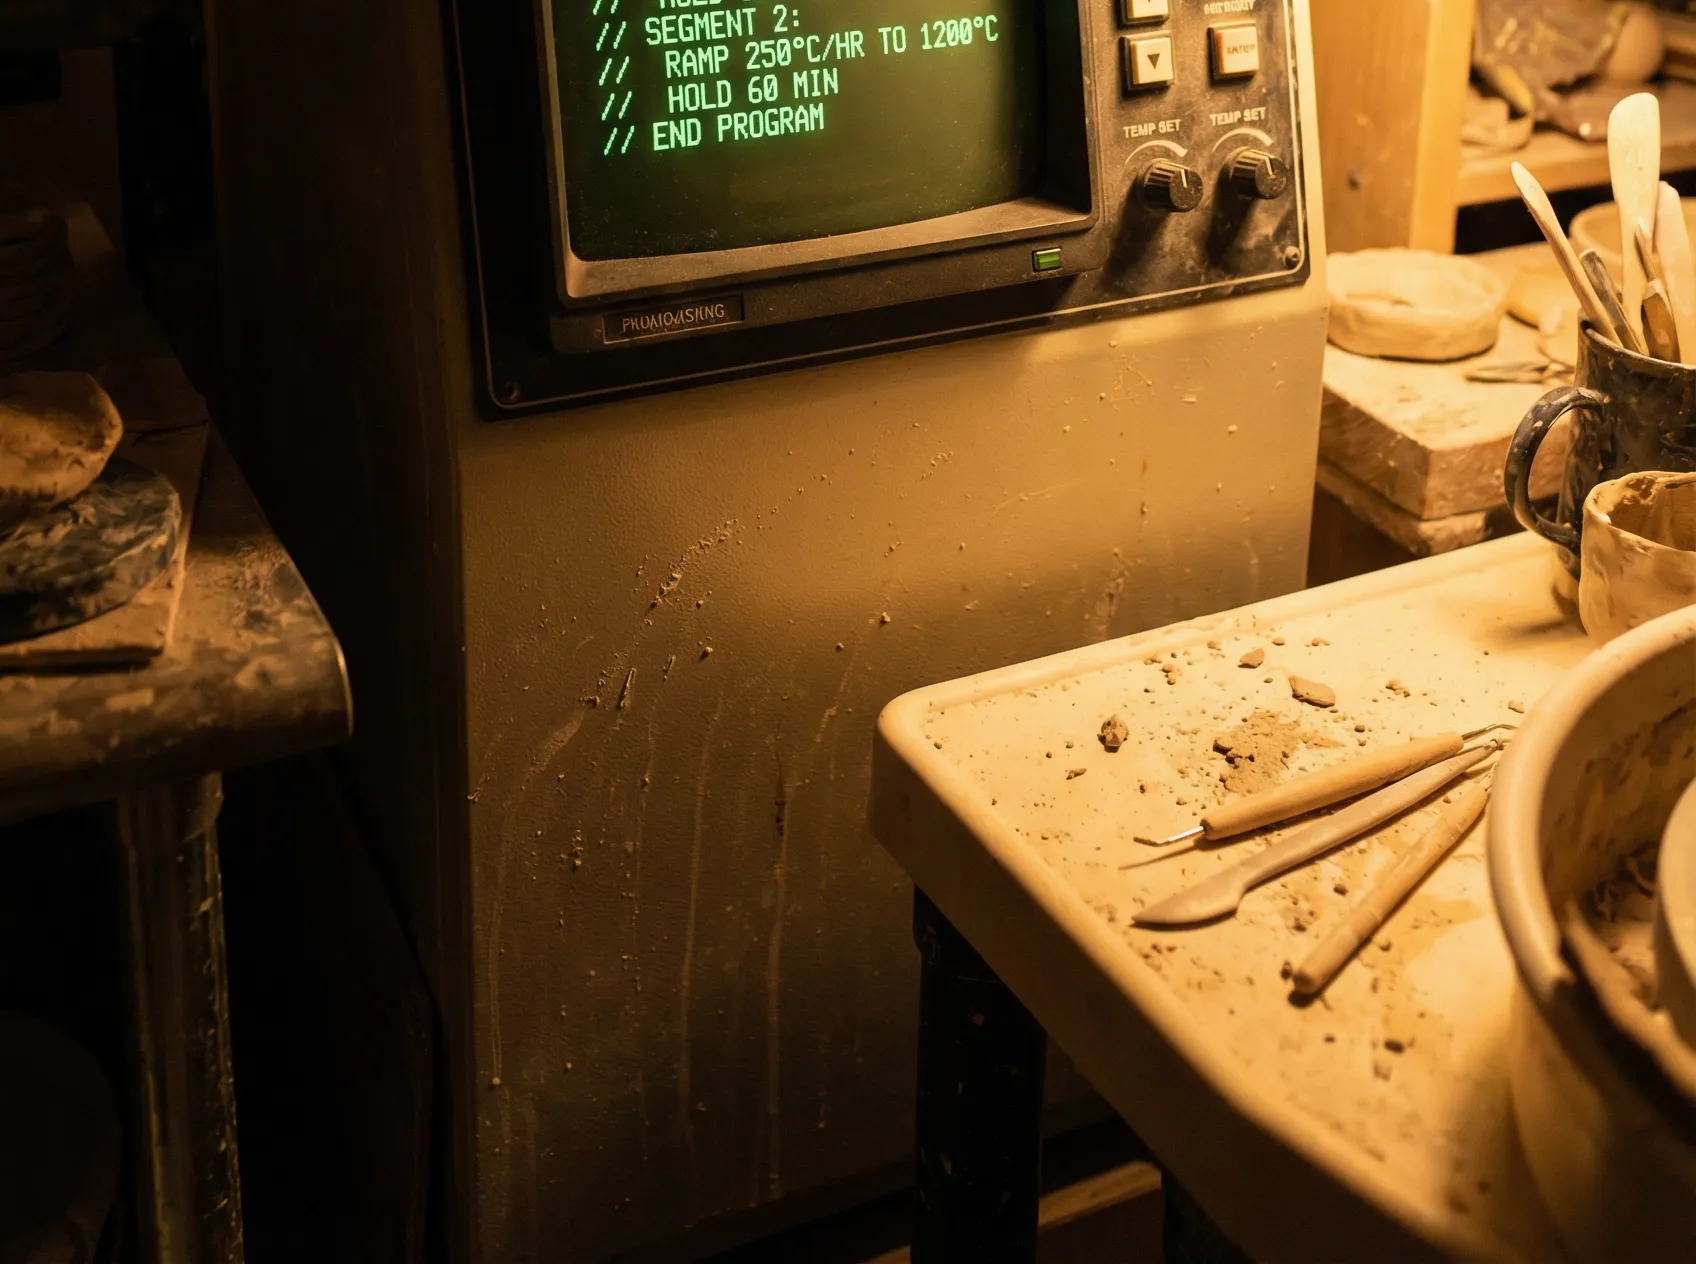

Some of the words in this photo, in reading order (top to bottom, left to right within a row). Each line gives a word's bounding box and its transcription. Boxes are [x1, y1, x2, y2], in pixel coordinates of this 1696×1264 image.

[595, 21, 627, 51] //
[644, 8, 756, 46] SEGMENT
[772, 5, 801, 33] 2:
[598, 56, 630, 86] //
[665, 45, 730, 78] RAMP
[745, 32, 866, 71] 250°C/HR
[878, 25, 907, 55] TO
[920, 15, 999, 50] 1200°C
[601, 91, 633, 121] //
[667, 80, 732, 114] HOLD
[747, 74, 778, 105] 60
[792, 67, 840, 99] MIN
[603, 126, 635, 156] //
[652, 118, 702, 151] END
[717, 104, 825, 142] PROGRAM
[1123, 122, 1157, 139] TEMP
[1210, 111, 1242, 127] TEMP
